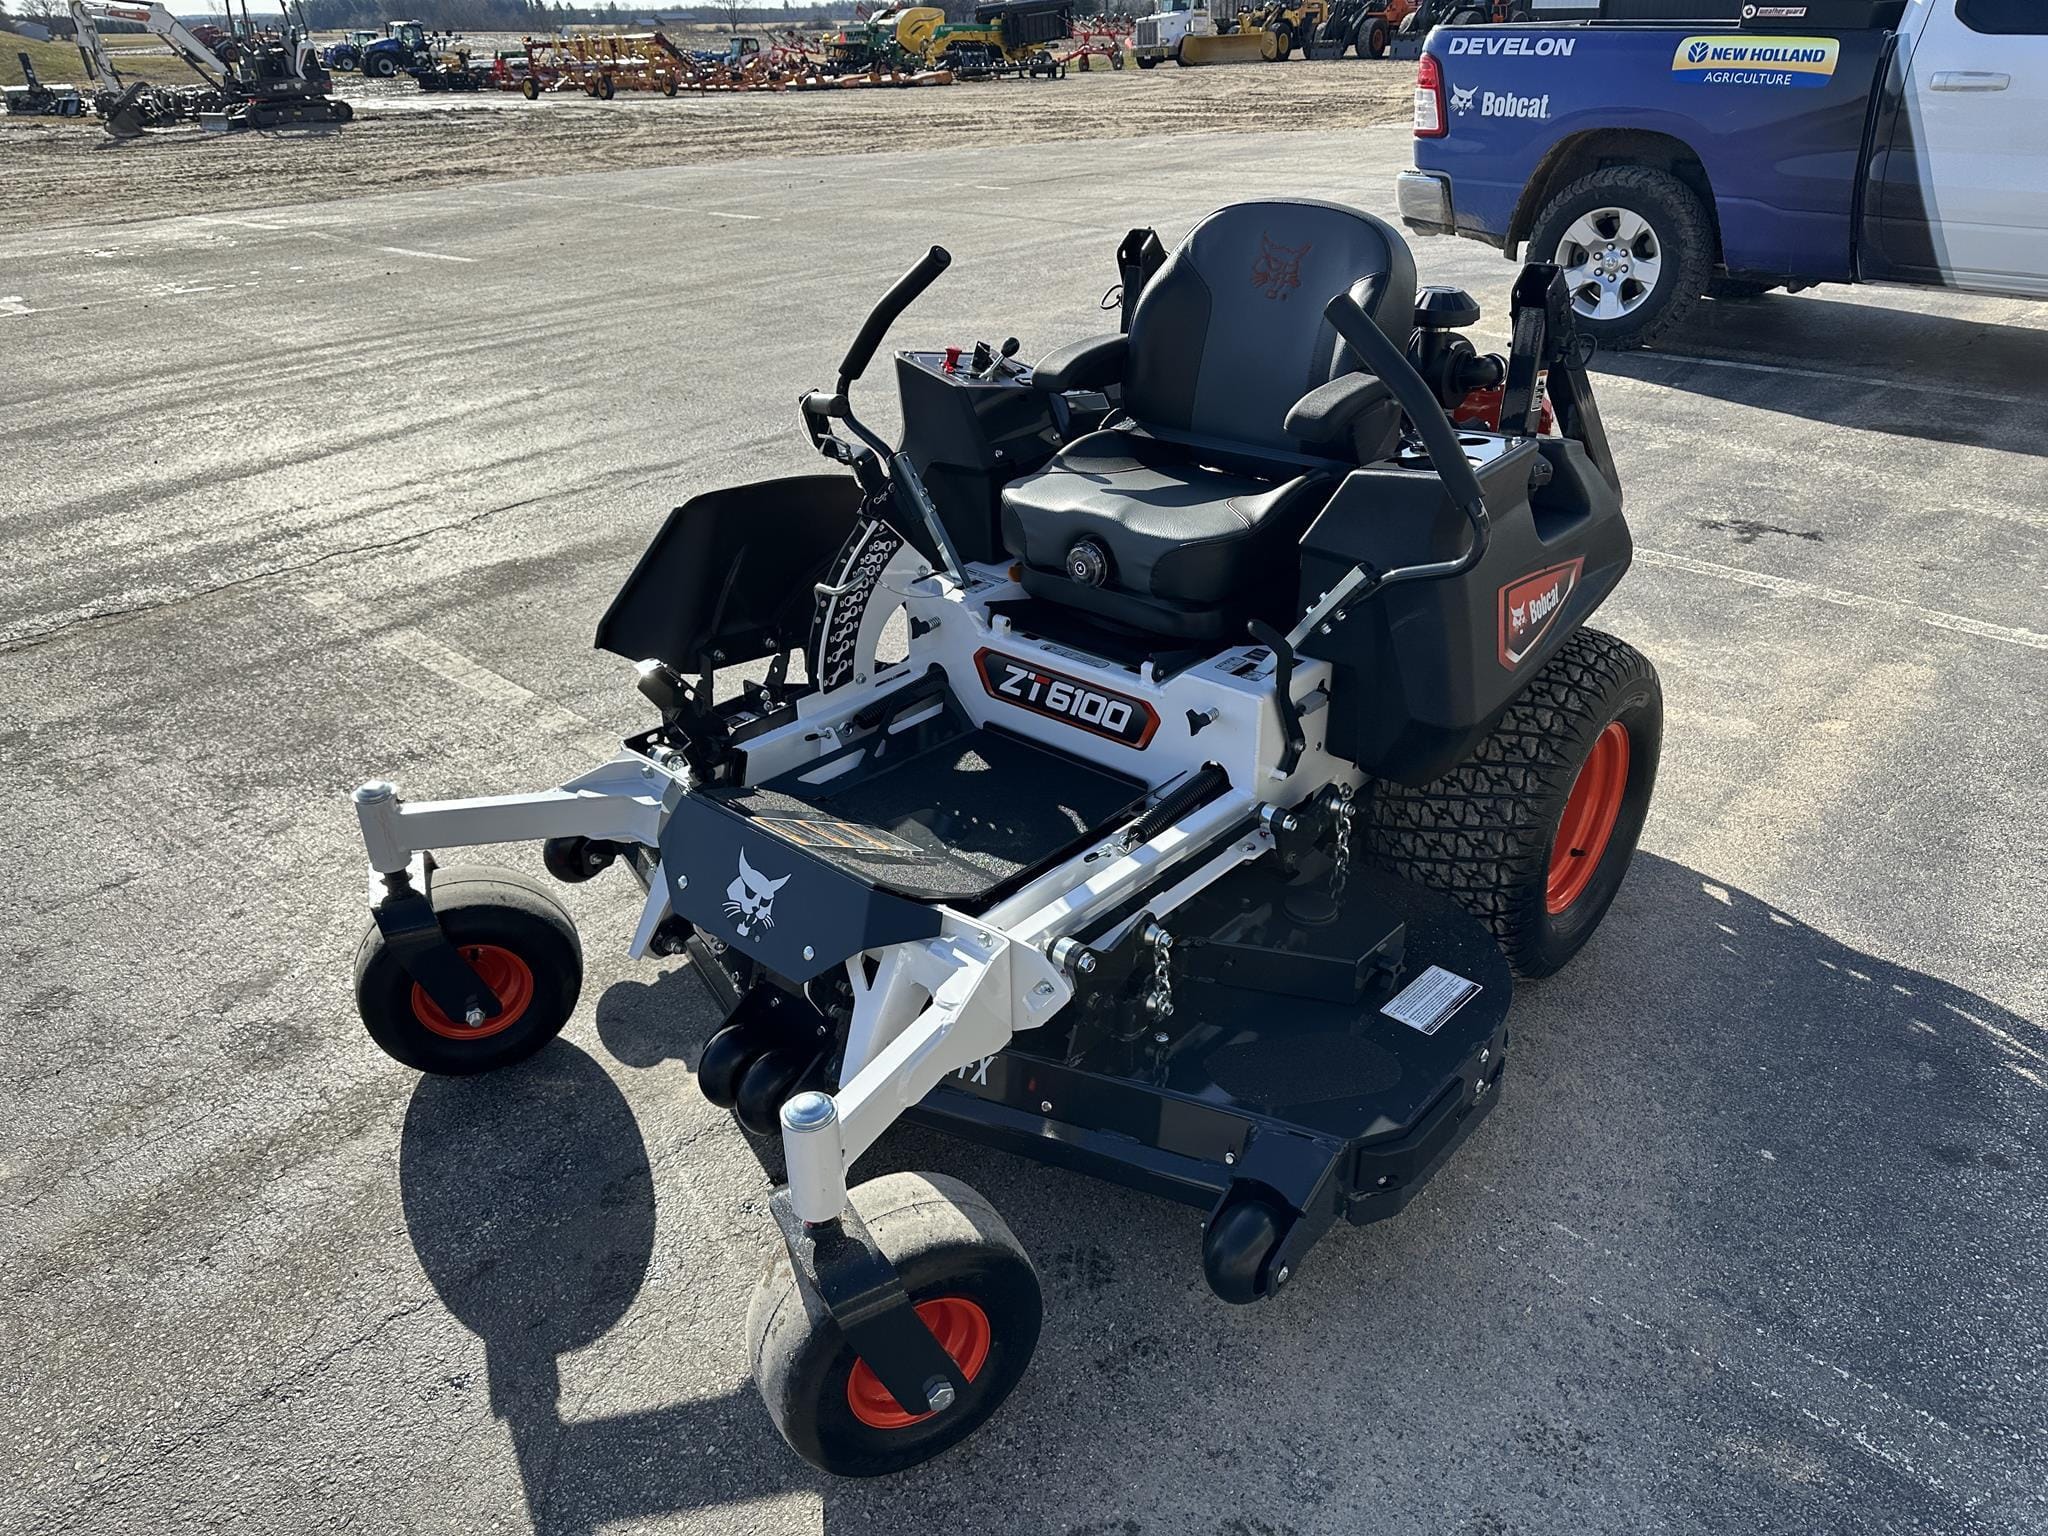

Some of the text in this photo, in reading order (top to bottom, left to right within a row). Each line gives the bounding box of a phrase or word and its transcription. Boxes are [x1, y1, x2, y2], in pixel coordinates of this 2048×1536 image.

[1448, 37, 1576, 56] DEVELON
[1711, 47, 1826, 63] NEW HOLLAND
[1704, 71, 1793, 85] AGRICULTURE
[1481, 91, 1550, 119] Bobcat
[1529, 582, 1559, 624] Bobcat
[998, 664, 1133, 733] ZT6100
